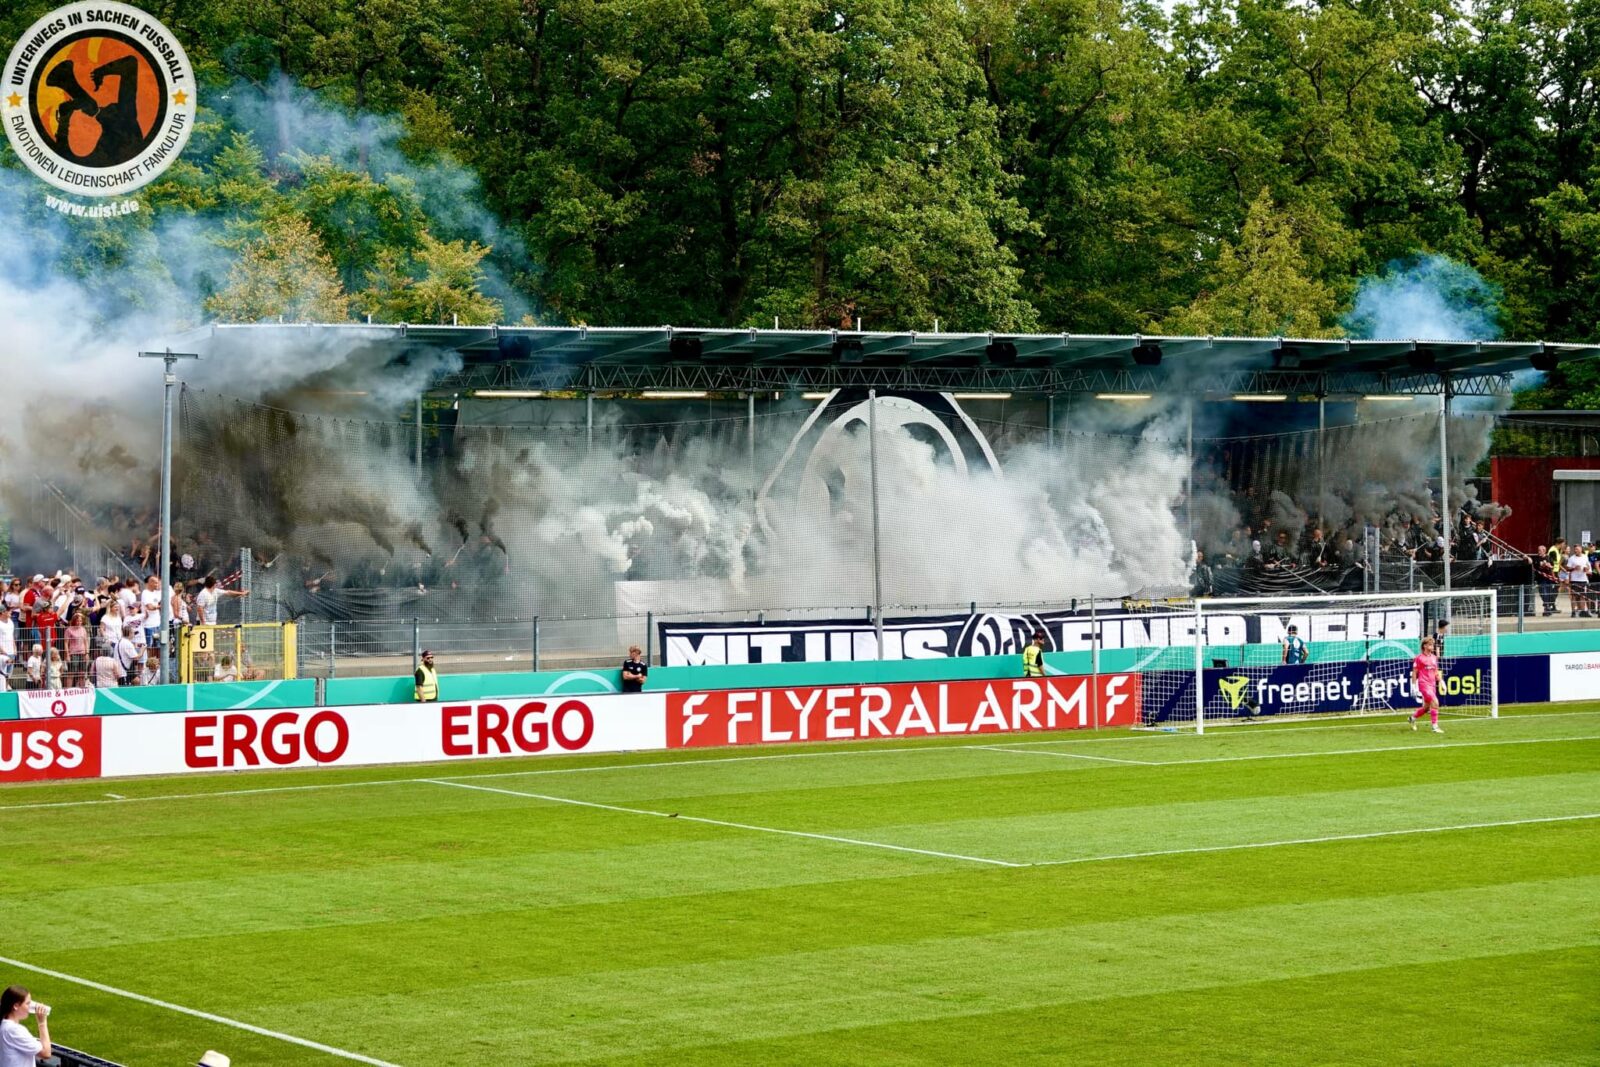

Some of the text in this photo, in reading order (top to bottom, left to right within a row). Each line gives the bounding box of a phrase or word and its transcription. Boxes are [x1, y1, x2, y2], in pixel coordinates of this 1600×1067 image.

[200, 631, 207, 649] 8
[666, 633, 791, 667] MIT
[727, 678, 1088, 744] FLYERALARM
[1257, 676, 1359, 706] freenet,
[184, 710, 349, 768] ERGO
[441, 699, 594, 756] ERGO
